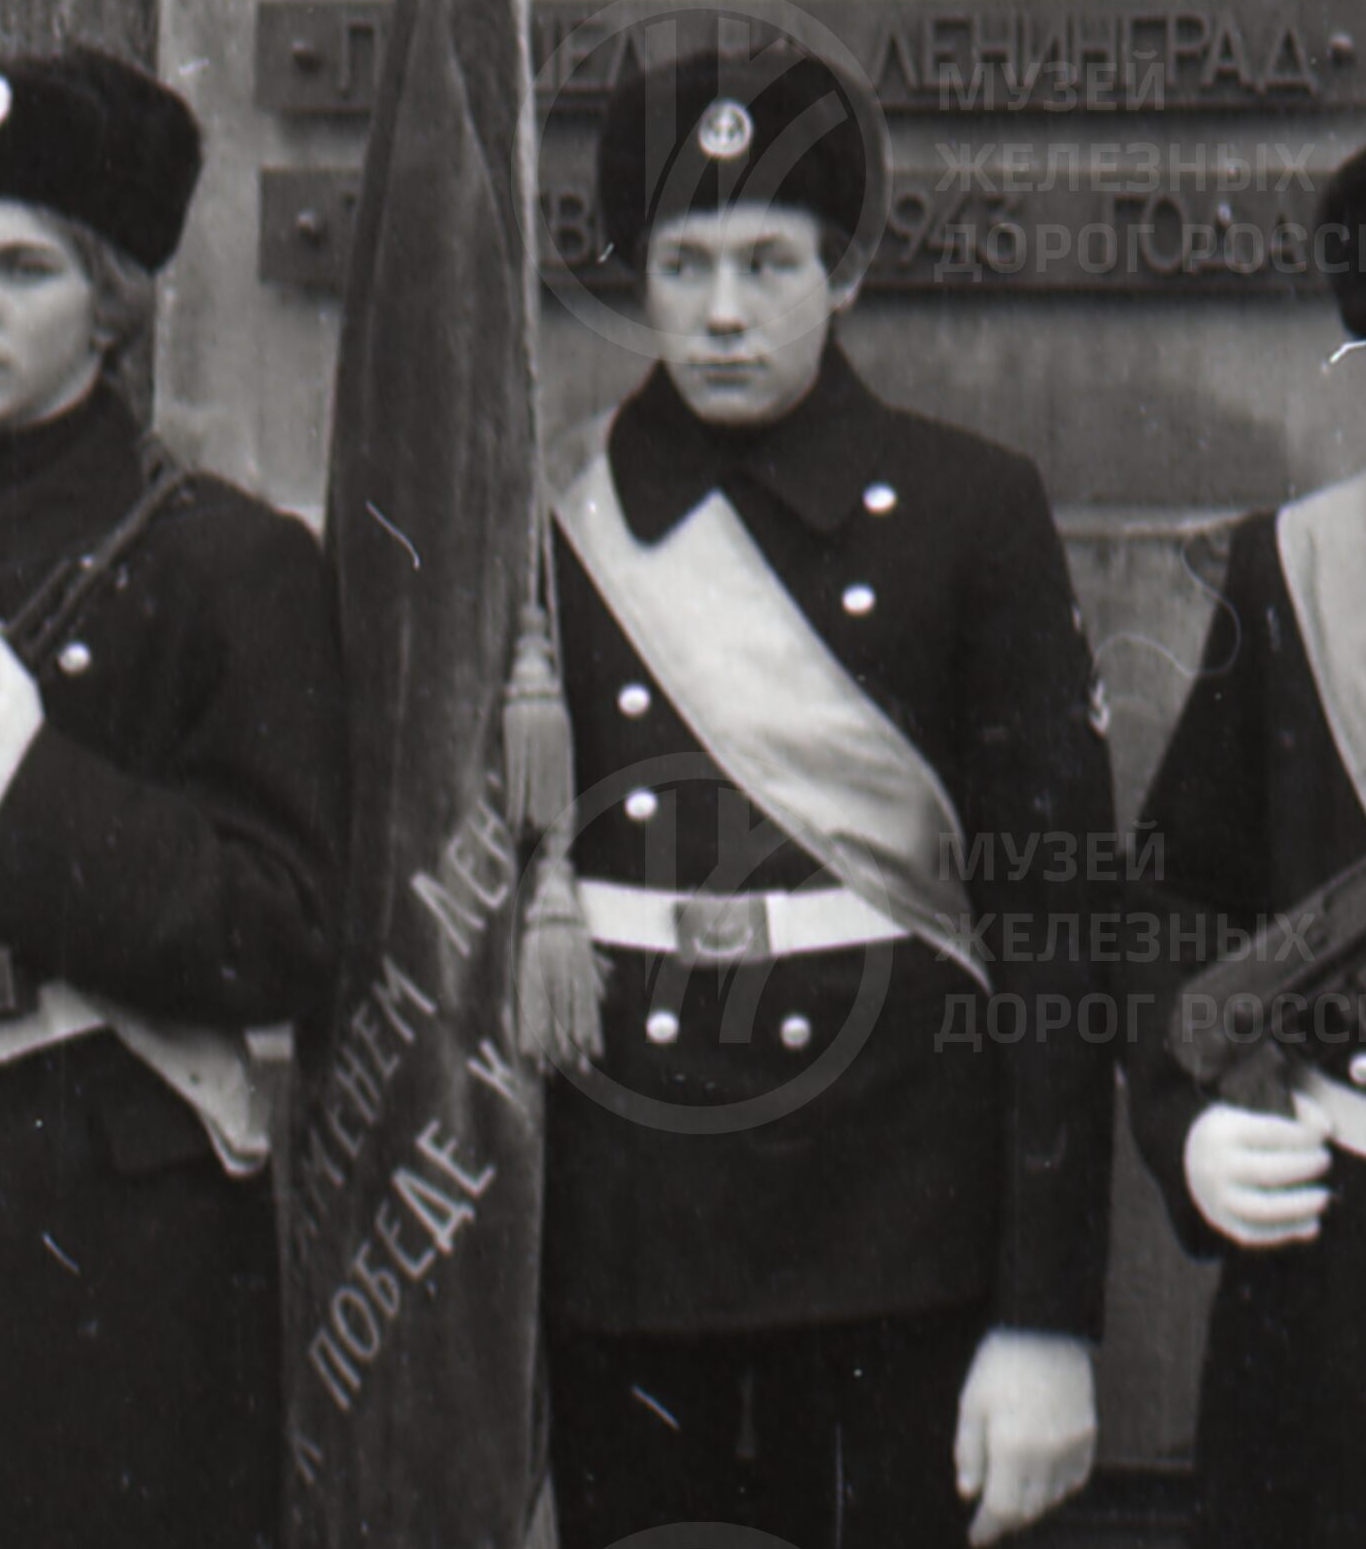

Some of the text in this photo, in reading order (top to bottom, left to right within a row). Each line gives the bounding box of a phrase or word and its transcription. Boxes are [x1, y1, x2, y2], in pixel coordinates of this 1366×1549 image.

[870, 7, 1318, 97] ЛЕНИНГРАД
[888, 184, 1029, 266] 943
[306, 1115, 499, 1415] ПОБЕДЕ
